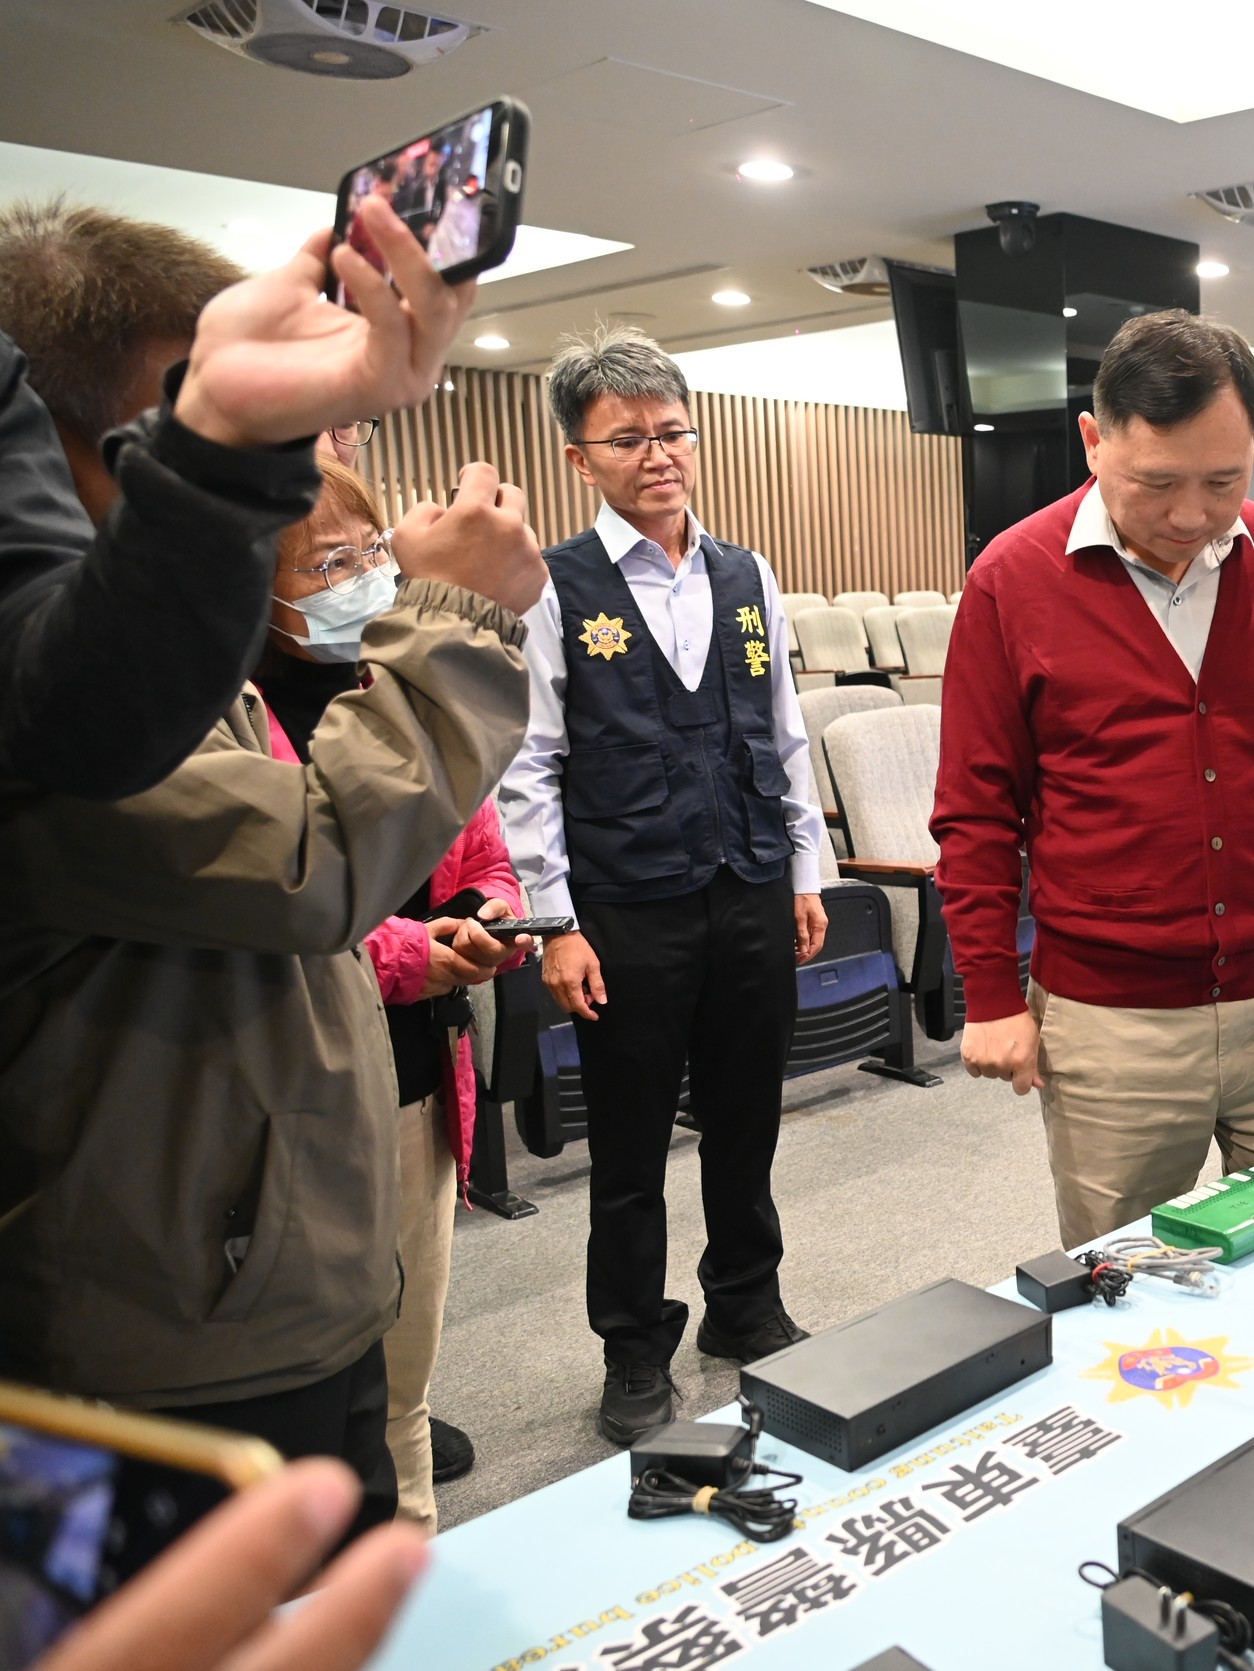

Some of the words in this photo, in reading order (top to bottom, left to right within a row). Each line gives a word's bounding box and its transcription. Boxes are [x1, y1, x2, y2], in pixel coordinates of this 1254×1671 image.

[736, 604, 771, 677] 刑警
[887, 1411, 1024, 1479] Taitung
[792, 1477, 887, 1530] count
[556, 1406, 1122, 1671] 臺東縣警察
[634, 1539, 759, 1605] police
